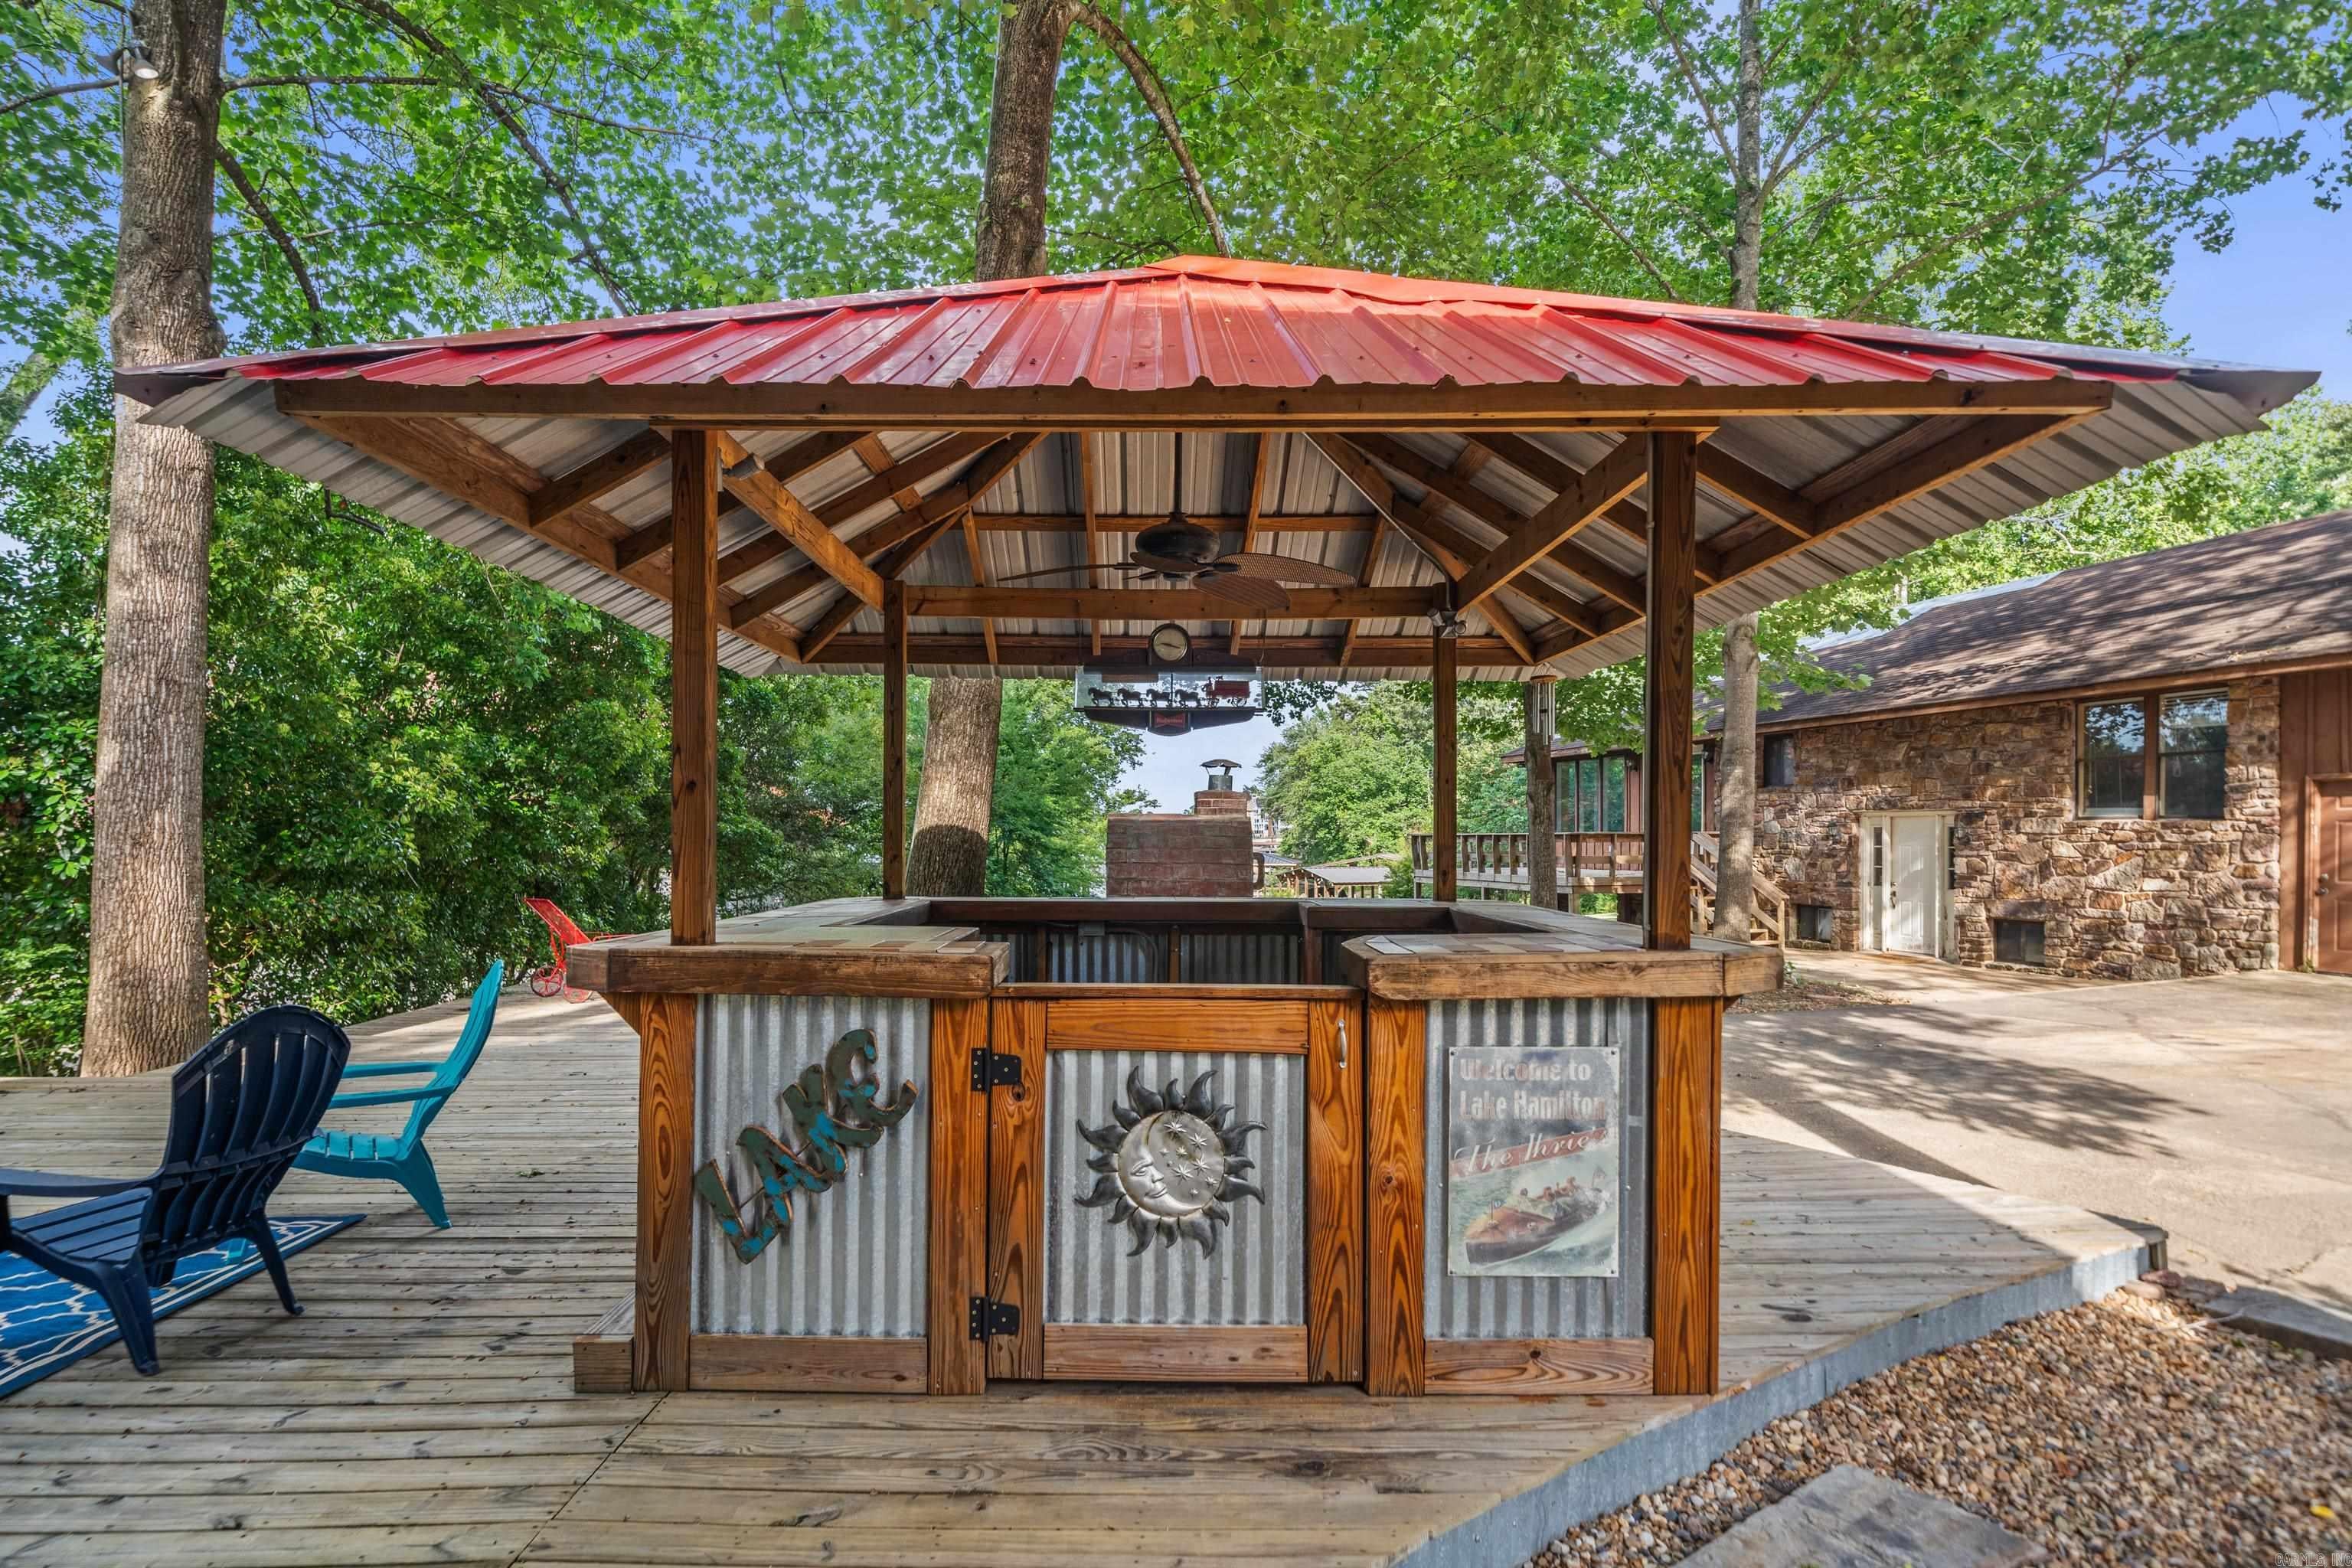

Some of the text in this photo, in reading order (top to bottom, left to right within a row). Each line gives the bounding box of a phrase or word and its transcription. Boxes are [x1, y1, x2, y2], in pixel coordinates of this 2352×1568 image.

[1459, 1059, 1592, 1081] Welcome to
[1459, 1090, 1606, 1121] Lake Hamilton
[1454, 1136, 1514, 1172] The
